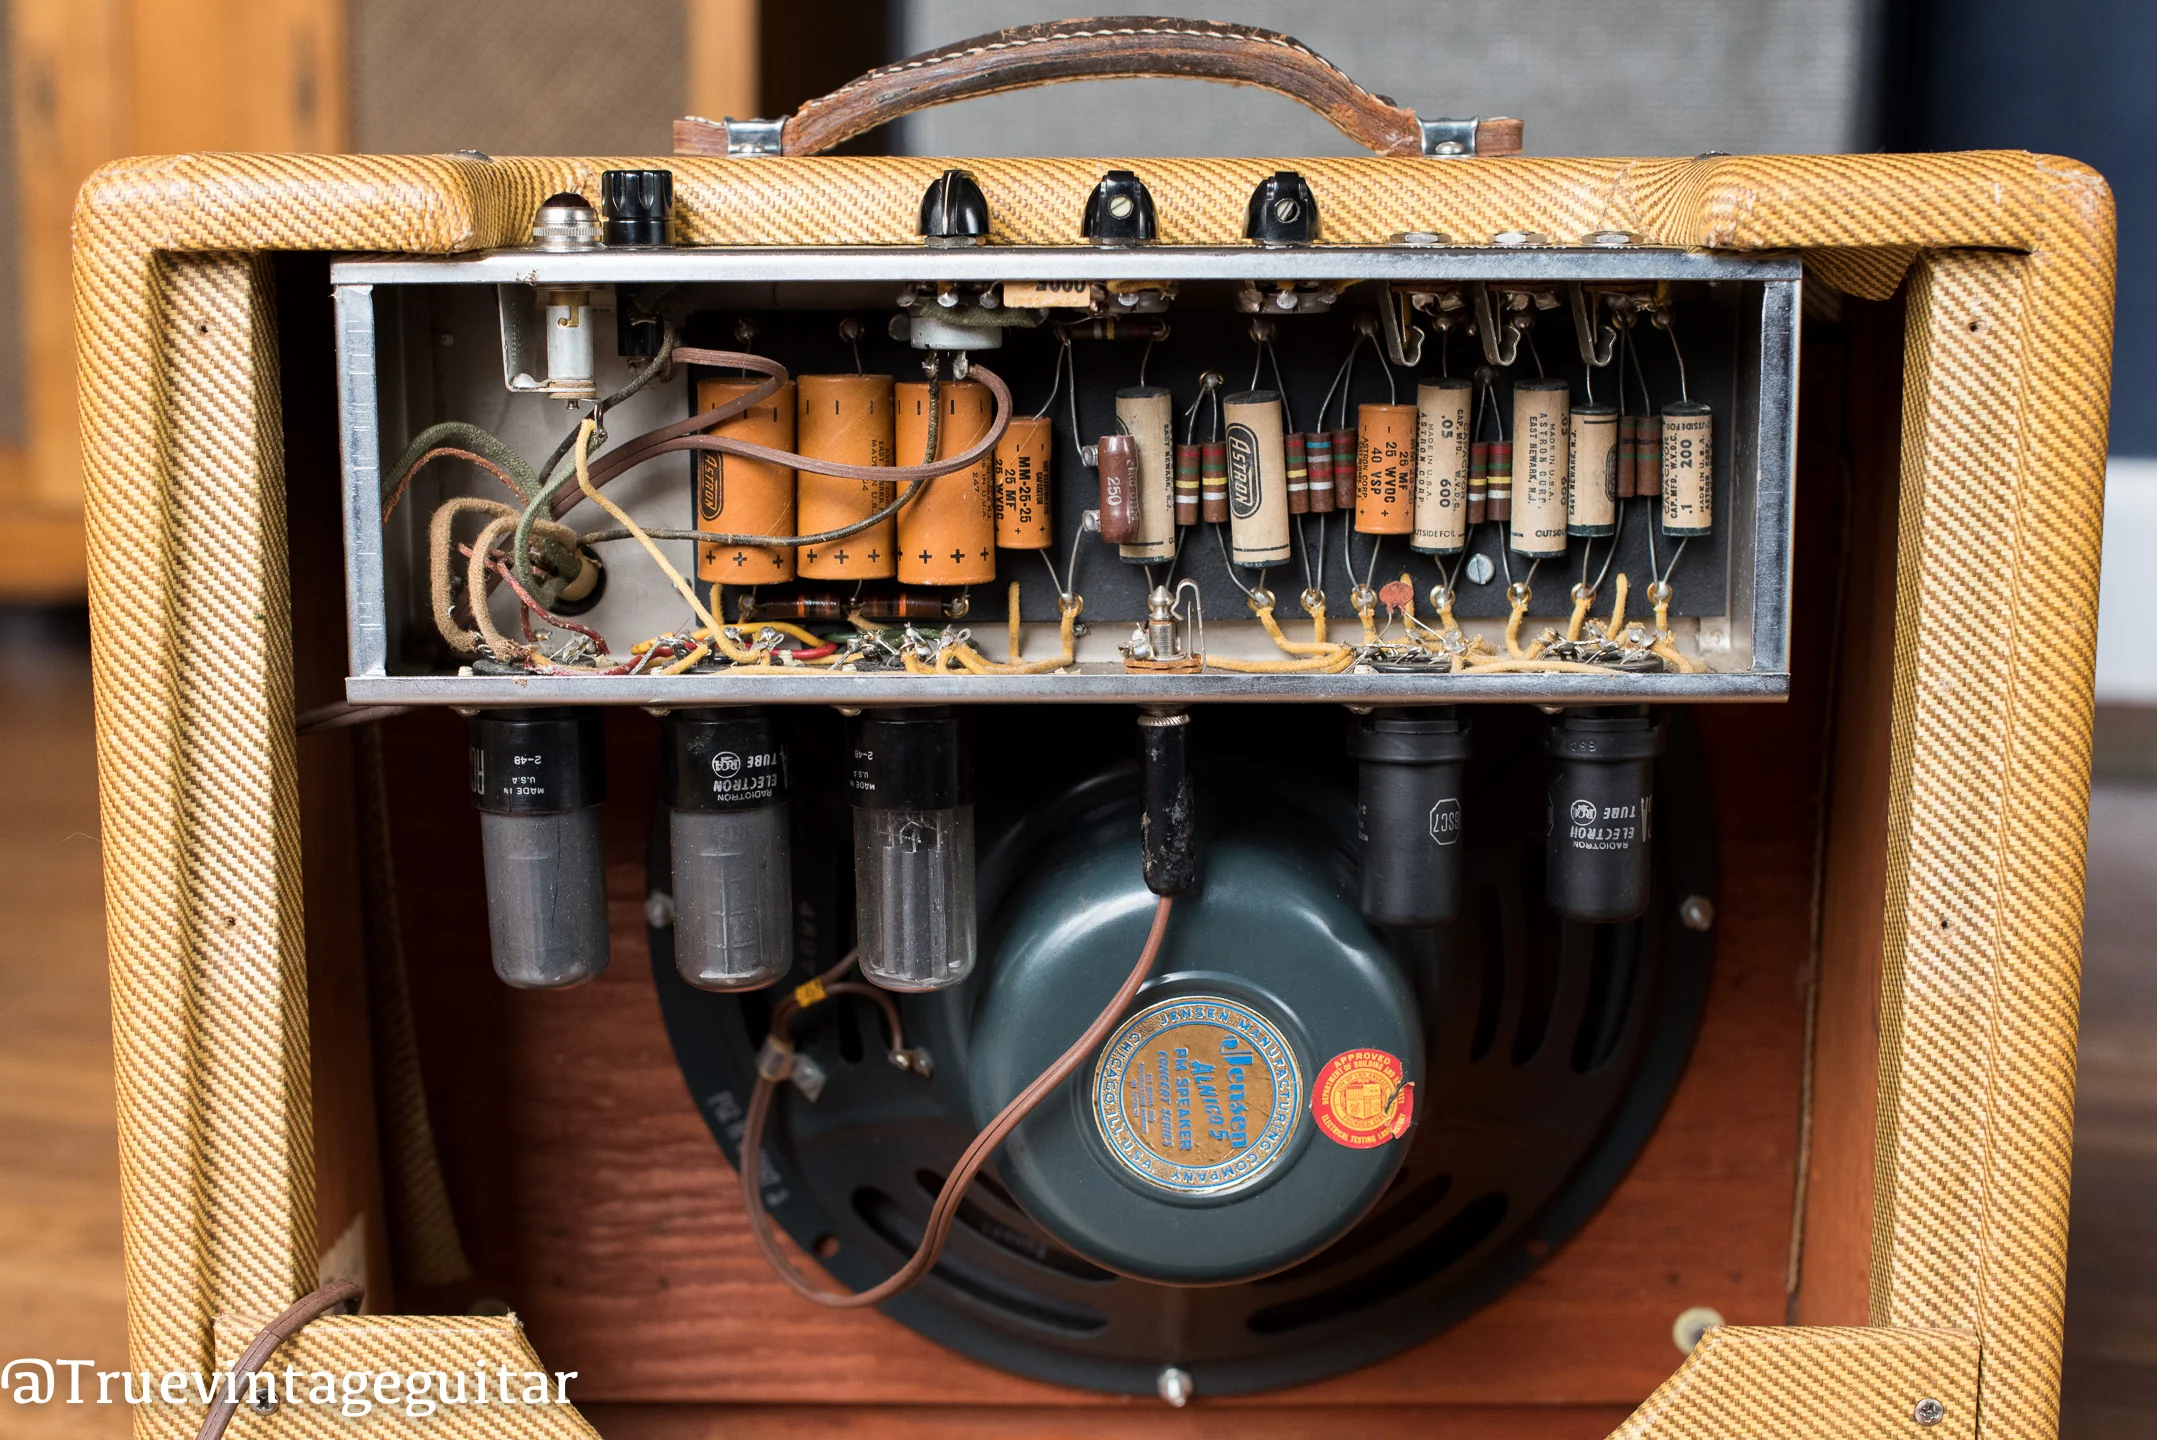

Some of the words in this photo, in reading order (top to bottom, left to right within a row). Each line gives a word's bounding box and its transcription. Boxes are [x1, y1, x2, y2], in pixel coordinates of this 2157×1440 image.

[1419, 412, 1427, 462] ASTRON
[1441, 415, 1453, 439] .05
[1529, 416, 1538, 438] EAST
[1539, 413, 1548, 463] ASTRON
[1371, 447, 1382, 463] 40
[1385, 441, 1397, 457] 25
[1455, 432, 1463, 456] MFD.
[1680, 439, 1693, 468] 200
[995, 458, 1003, 474] 25
[1399, 451, 1408, 467] 25
[1427, 455, 1433, 464] IN
[1528, 443, 1537, 483] NEWARK,
[1549, 455, 1555, 464] IN
[703, 452, 718, 510] ASTRON
[1005, 469, 1016, 485] 25
[1229, 437, 1250, 506] ASTRON
[1370, 471, 1382, 495] VSP
[1399, 472, 1408, 491] MF
[1699, 472, 1705, 482] IN
[1018, 456, 1032, 523] MM-25-25
[1106, 476, 1122, 505] 250
[1361, 475, 1369, 501] CORP.
[1384, 466, 1396, 503] WVDC
[1417, 470, 1426, 509] CORP.
[1439, 478, 1452, 508] 600
[1453, 470, 1461, 512] W.V.D.C.
[1005, 489, 1017, 511] MF
[1681, 504, 1692, 515] .1
[1414, 529, 1438, 537] UTSIDE
[514, 755, 541, 765] 2-48
[747, 752, 777, 768] TUBE
[854, 749, 874, 761] 2-48
[713, 773, 777, 792] ELECTRON
[856, 781, 876, 791] MADE
[717, 789, 772, 801] RADIOTRON
[1432, 811, 1460, 833] 6SC7
[1603, 806, 1636, 819] TUBE
[1572, 841, 1628, 850] RADIOTRON
[1159, 1007, 1230, 1026] JENSEN
[1174, 1047, 1189, 1071] PM
[1334, 1052, 1391, 1068] APPROVED
[1157, 1050, 1171, 1104] CONCERT
[1237, 1018, 1291, 1152] MANUFACTURING
[1321, 1067, 1346, 1105] DEPARTMENT
[1344, 1063, 1352, 1071] OF
[1354, 1060, 1383, 1070] BUILDING
[1383, 1066, 1396, 1079] AND
[1189, 1060, 1224, 1126] ALNICO
[1209, 1128, 1231, 1141] 5
[1219, 1034, 1253, 1148] Jensen
[1175, 1077, 1193, 1150] SPEAKER
[1161, 1107, 1174, 1147] SERIES
[1321, 1114, 1349, 1141] ELECTRICAL
[1350, 1135, 1377, 1144] TESTING
[1171, 1151, 1259, 1183] COMPANY
